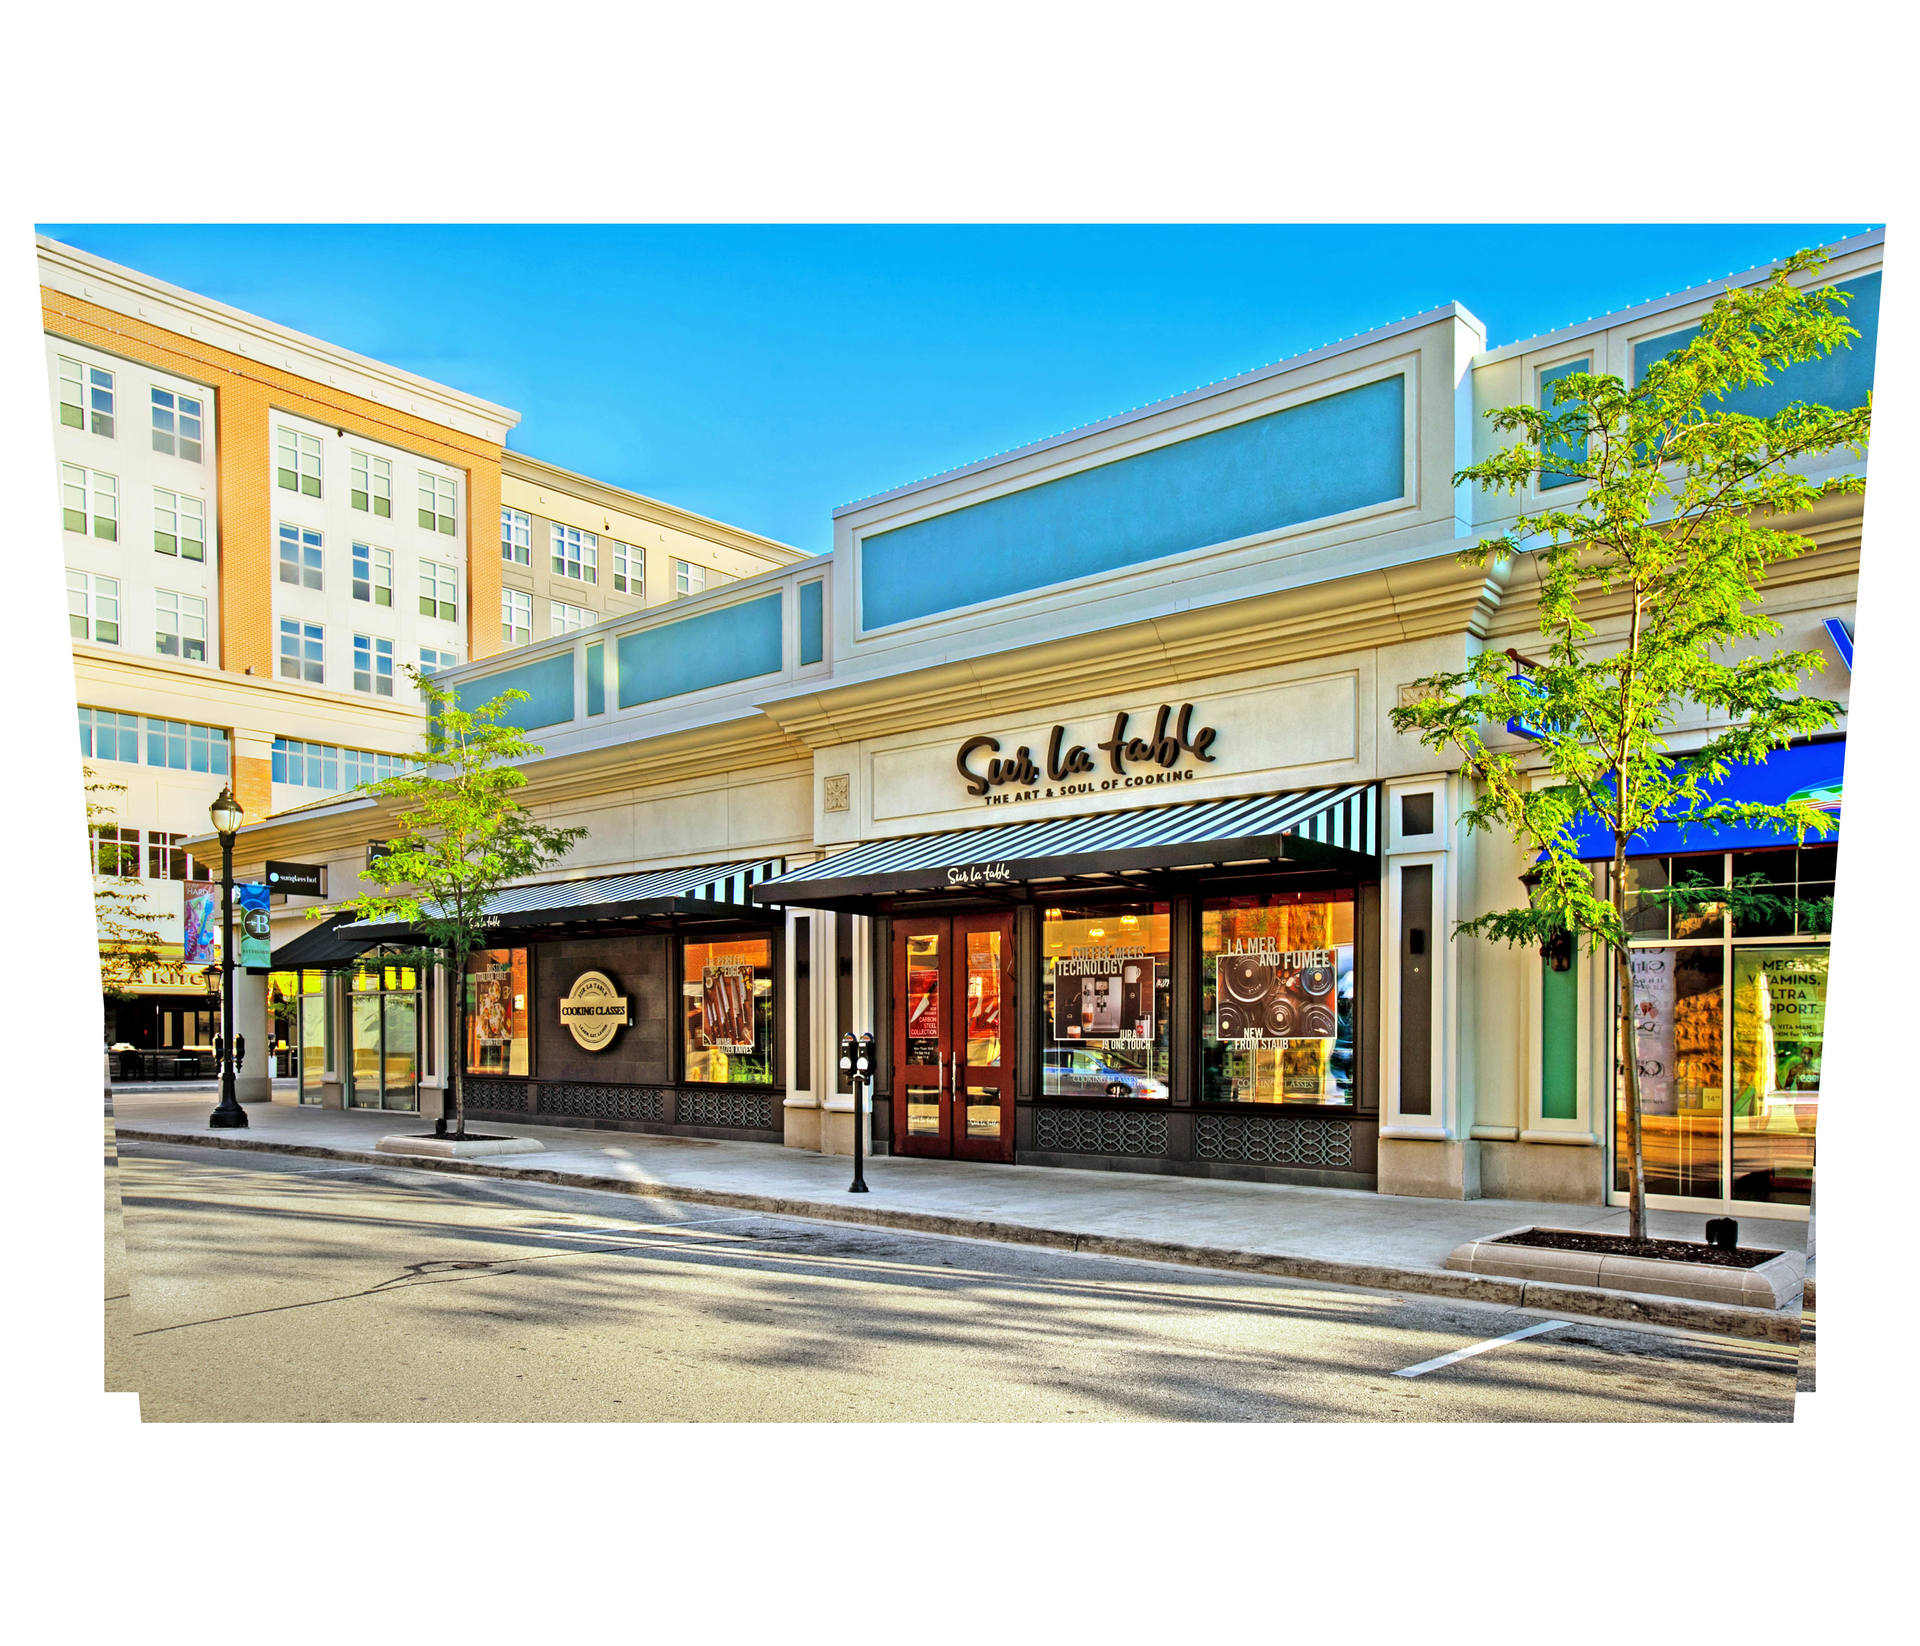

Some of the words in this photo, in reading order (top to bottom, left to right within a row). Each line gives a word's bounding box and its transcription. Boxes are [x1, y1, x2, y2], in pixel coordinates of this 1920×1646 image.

[957, 736, 1040, 796] Sur
[1047, 725, 1094, 781] la
[1098, 703, 1217, 775] table
[985, 795, 1009, 806] THE
[1014, 789, 1040, 802] ART
[1046, 788, 1054, 798] &
[1060, 783, 1095, 796] SOUL
[1101, 779, 1119, 790] OF
[1124, 769, 1194, 787] COOKING
[947, 867, 968, 885] Sur
[970, 866, 982, 881] la
[983, 863, 1010, 881] table
[1228, 939, 1243, 955] LA
[1247, 936, 1277, 953] MER
[1114, 945, 1145, 959] MEETS
[1259, 953, 1280, 967] AND
[1284, 947, 1331, 969] FUMÉE
[1057, 960, 1124, 976] TECHNOLOGY
[1762, 960, 1807, 971] MEG
[1747, 974, 1821, 985] VTAMINS,
[1763, 989, 1807, 1000] LTRA
[562, 1006, 594, 1016] COOKING
[595, 1006, 625, 1016] CLASSES
[1748, 1003, 1819, 1015] SPPORT.
[1243, 1028, 1263, 1038] NEW
[1111, 1040, 1126, 1050] ONE
[1128, 1040, 1151, 1050] TOUCH
[1234, 1040, 1259, 1050] FROM
[1261, 1040, 1289, 1050] STAUB
[1237, 1079, 1275, 1089] COING
[1277, 1080, 1315, 1089] LASSES
